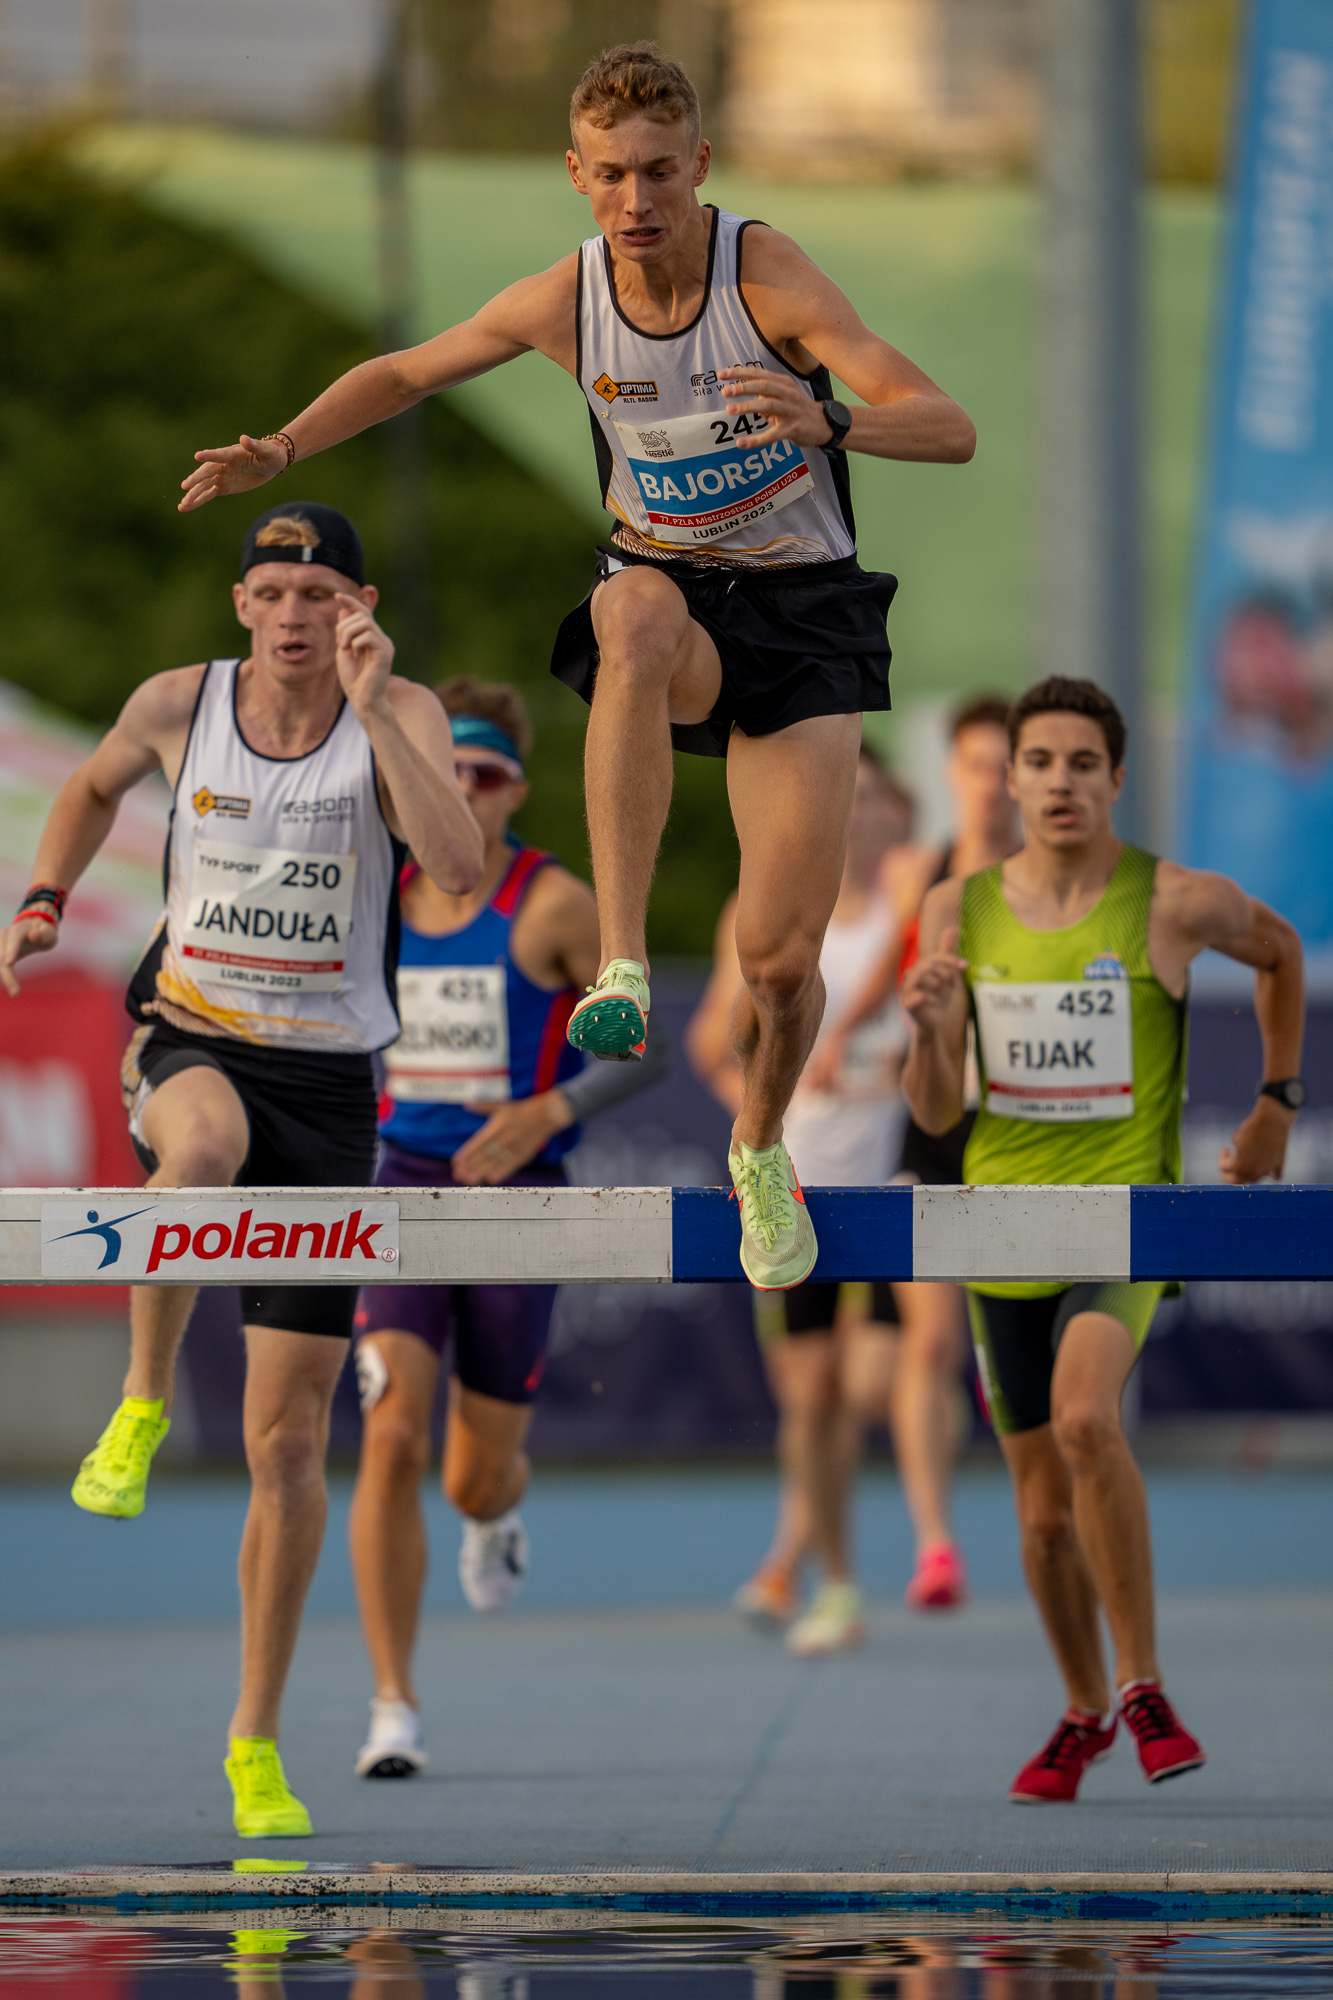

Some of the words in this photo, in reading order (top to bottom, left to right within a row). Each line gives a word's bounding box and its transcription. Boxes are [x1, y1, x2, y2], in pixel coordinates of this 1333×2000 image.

[620, 383, 656, 395] OPTIMA
[638, 437, 795, 502] BAJORSKI
[696, 501, 754, 525] Mistrzostwa
[754, 484, 781, 504] Polski
[781, 471, 799, 487] U20
[692, 518, 740, 540] LUBLIN
[742, 501, 775, 523] 2023
[199, 855, 220, 868] TVP
[222, 860, 262, 875] SPORT
[280, 861, 341, 890] 250
[193, 899, 340, 944] JANDUŁA
[220, 967, 266, 985] LUBLIN
[268, 974, 302, 987] 2023
[1057, 989, 1115, 1016] 452
[1007, 1039, 1096, 1070] FIJAK
[145, 1208, 385, 1275] polanik
